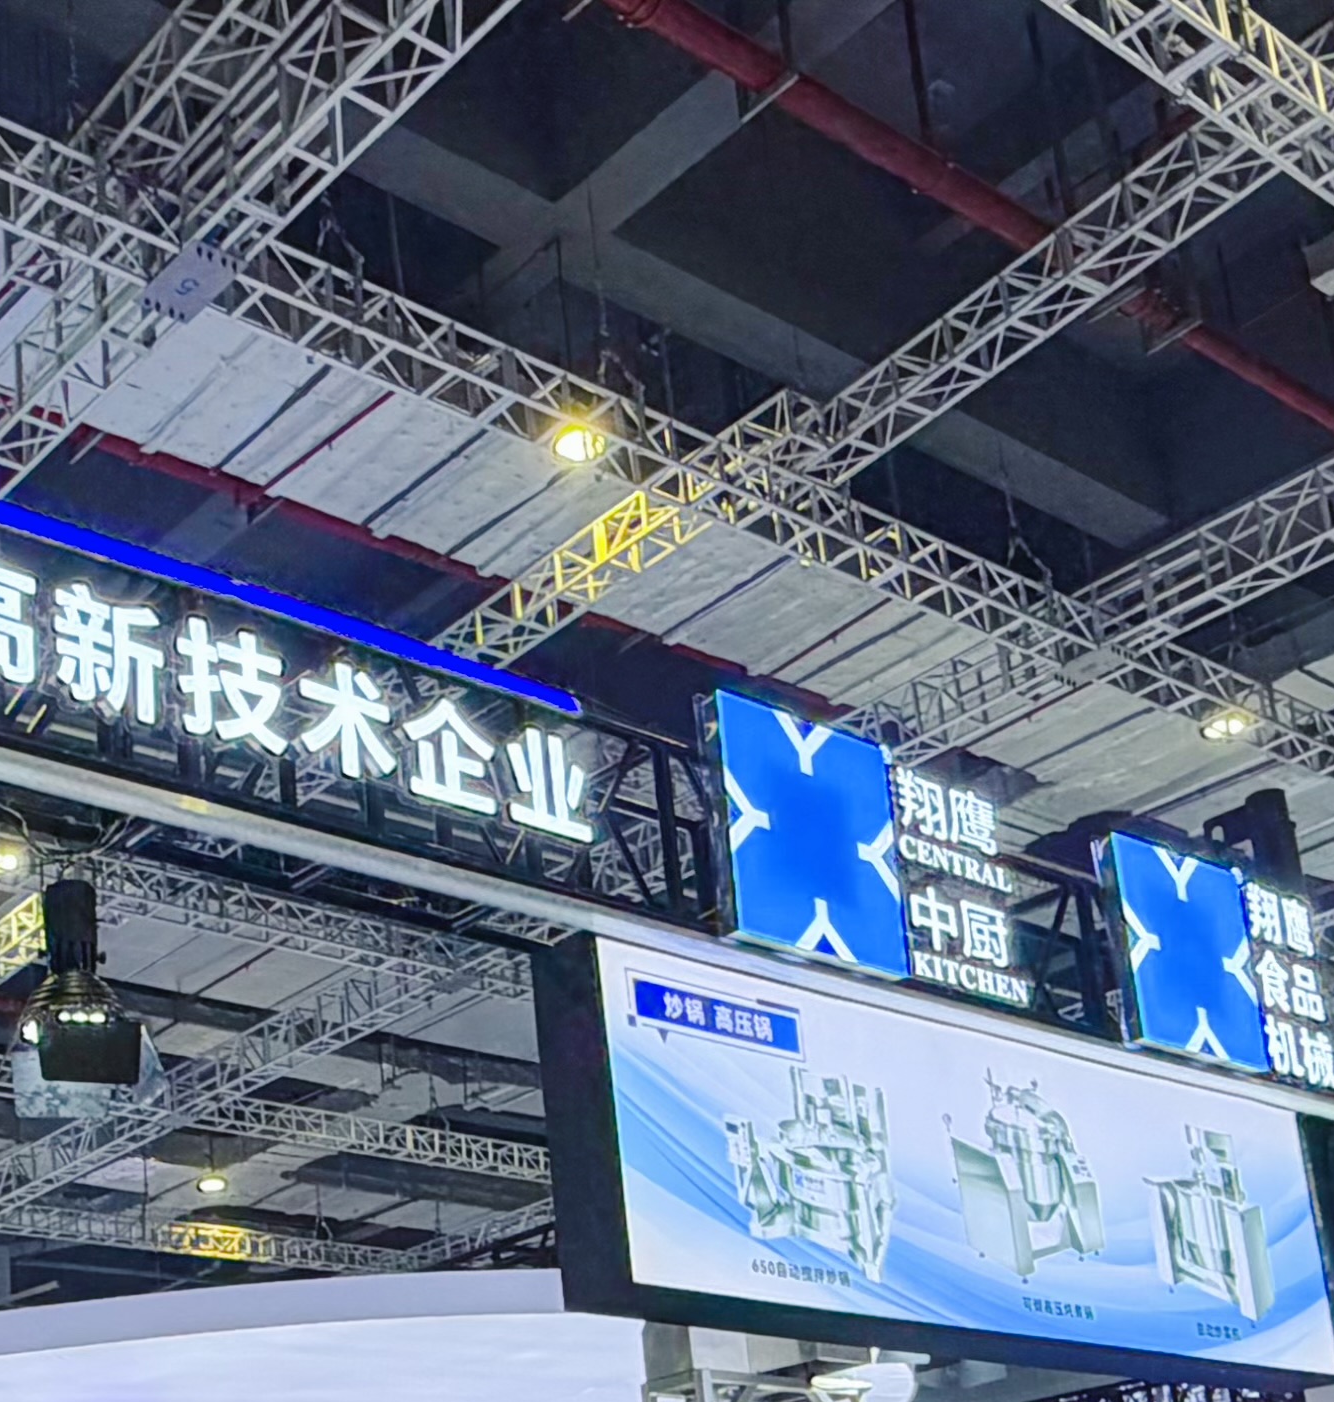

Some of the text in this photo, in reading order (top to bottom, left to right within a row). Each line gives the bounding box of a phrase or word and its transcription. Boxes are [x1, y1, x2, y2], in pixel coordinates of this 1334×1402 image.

[896, 766, 998, 857] 翔鹰
[898, 833, 1013, 893] CENTRAL
[910, 886, 1010, 968] 中厨
[1246, 881, 1315, 957] 翔鹰
[663, 990, 773, 1043] 炒锅 高压锅
[913, 949, 1030, 1010] KITCHEN
[1255, 949, 1328, 1023] 食品
